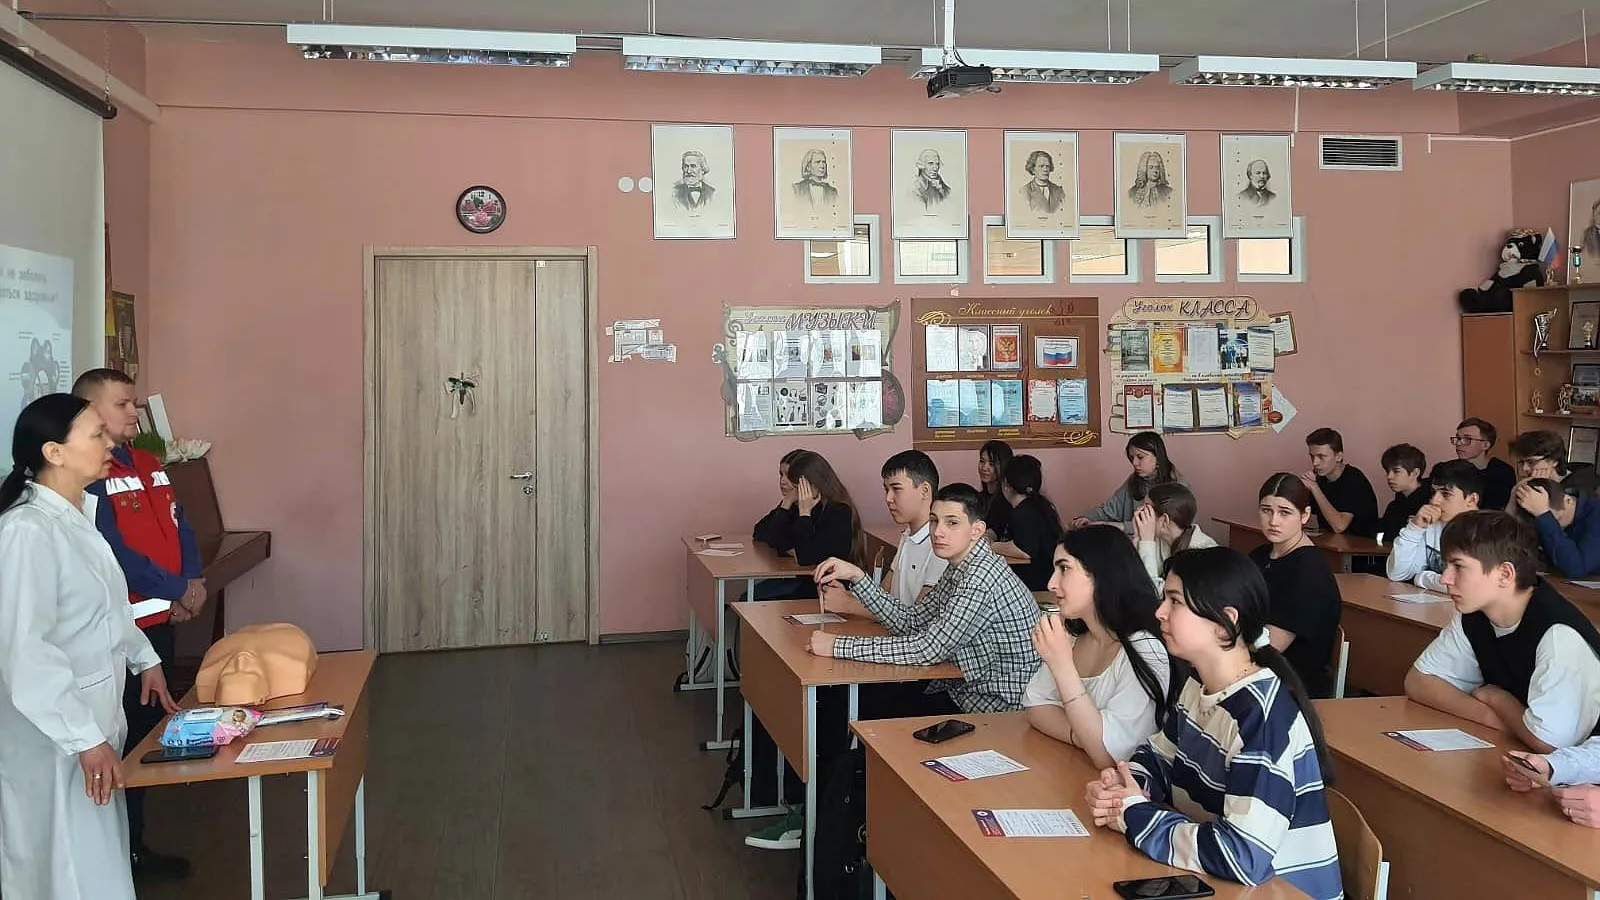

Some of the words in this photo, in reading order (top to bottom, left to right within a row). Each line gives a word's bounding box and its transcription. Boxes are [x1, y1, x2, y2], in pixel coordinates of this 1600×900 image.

[959, 300, 1016, 316] Классный
[1133, 299, 1173, 315] Уголок
[1179, 299, 1250, 318] КЛАССА
[785, 310, 878, 331] МУЗЫКИ
